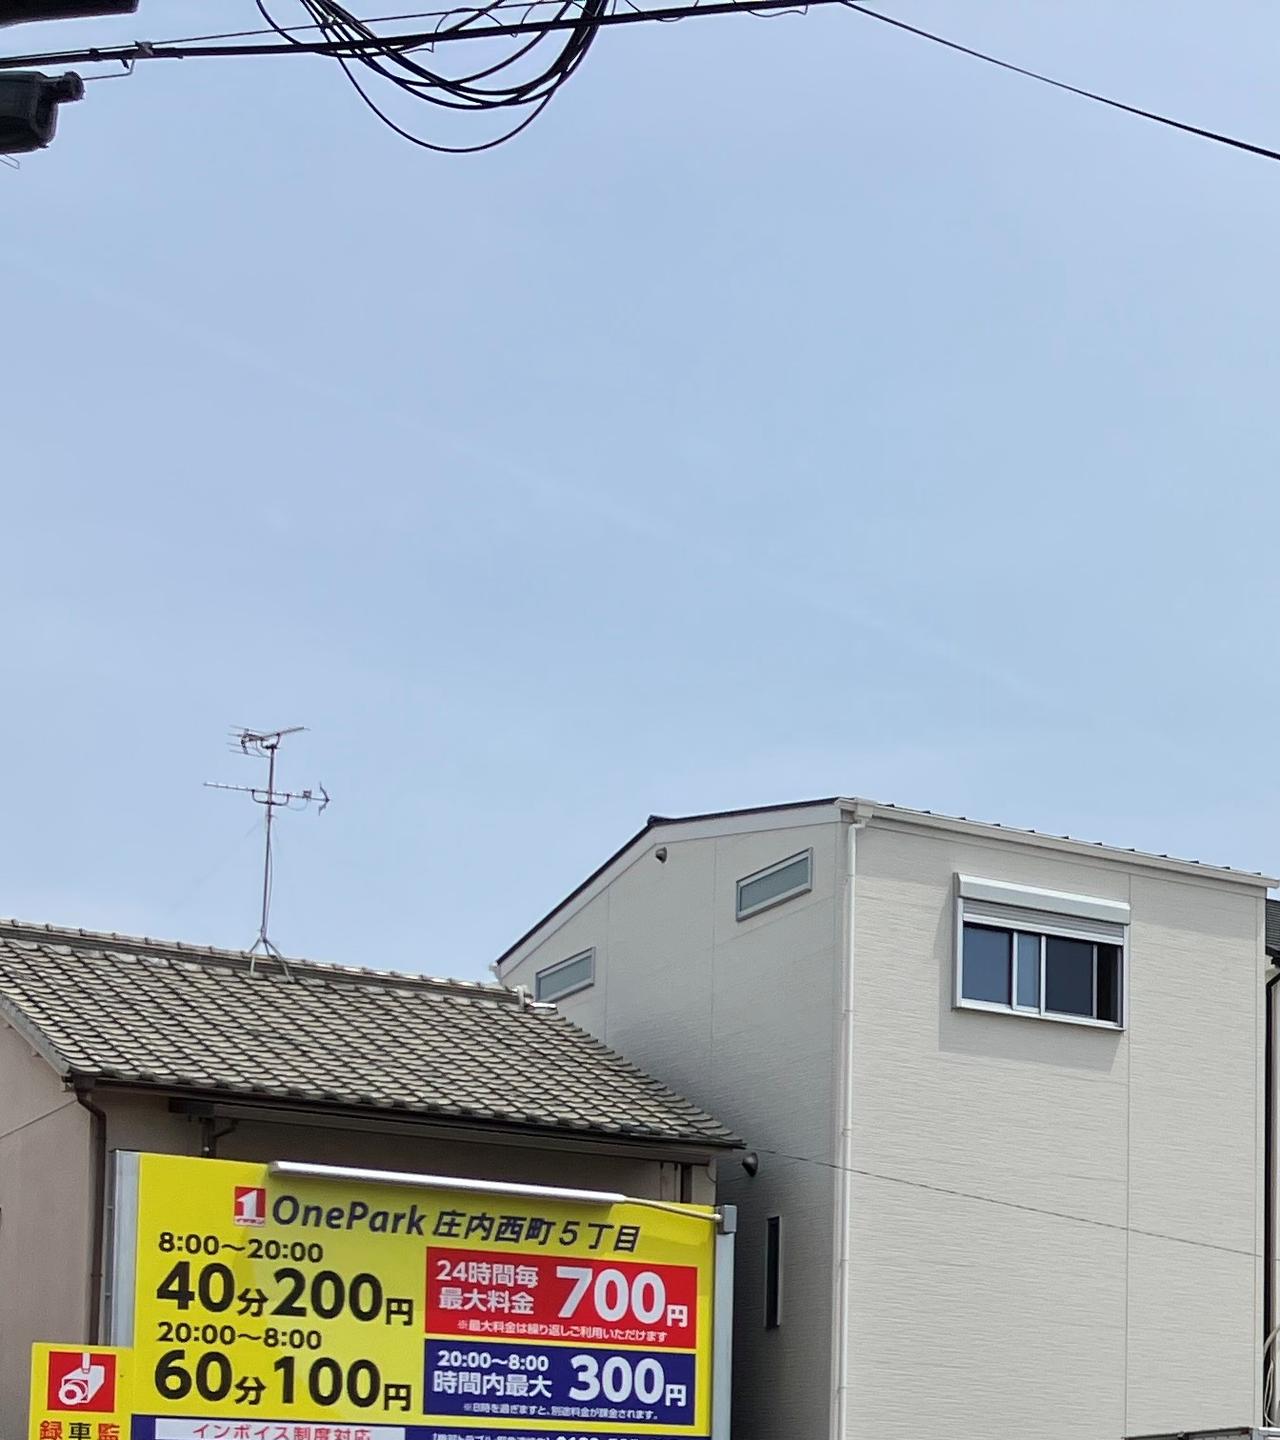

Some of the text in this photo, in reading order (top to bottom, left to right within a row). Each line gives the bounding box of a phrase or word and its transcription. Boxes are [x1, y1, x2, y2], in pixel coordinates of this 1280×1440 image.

[272, 1194, 427, 1237] OnePark
[435, 1259, 539, 1288] 24時間毎
[438, 1286, 535, 1315] 最大料金
[556, 1265, 688, 1328] 700円
[432, 1369, 553, 1398] 時間内最大
[568, 1354, 687, 1407] 300円
